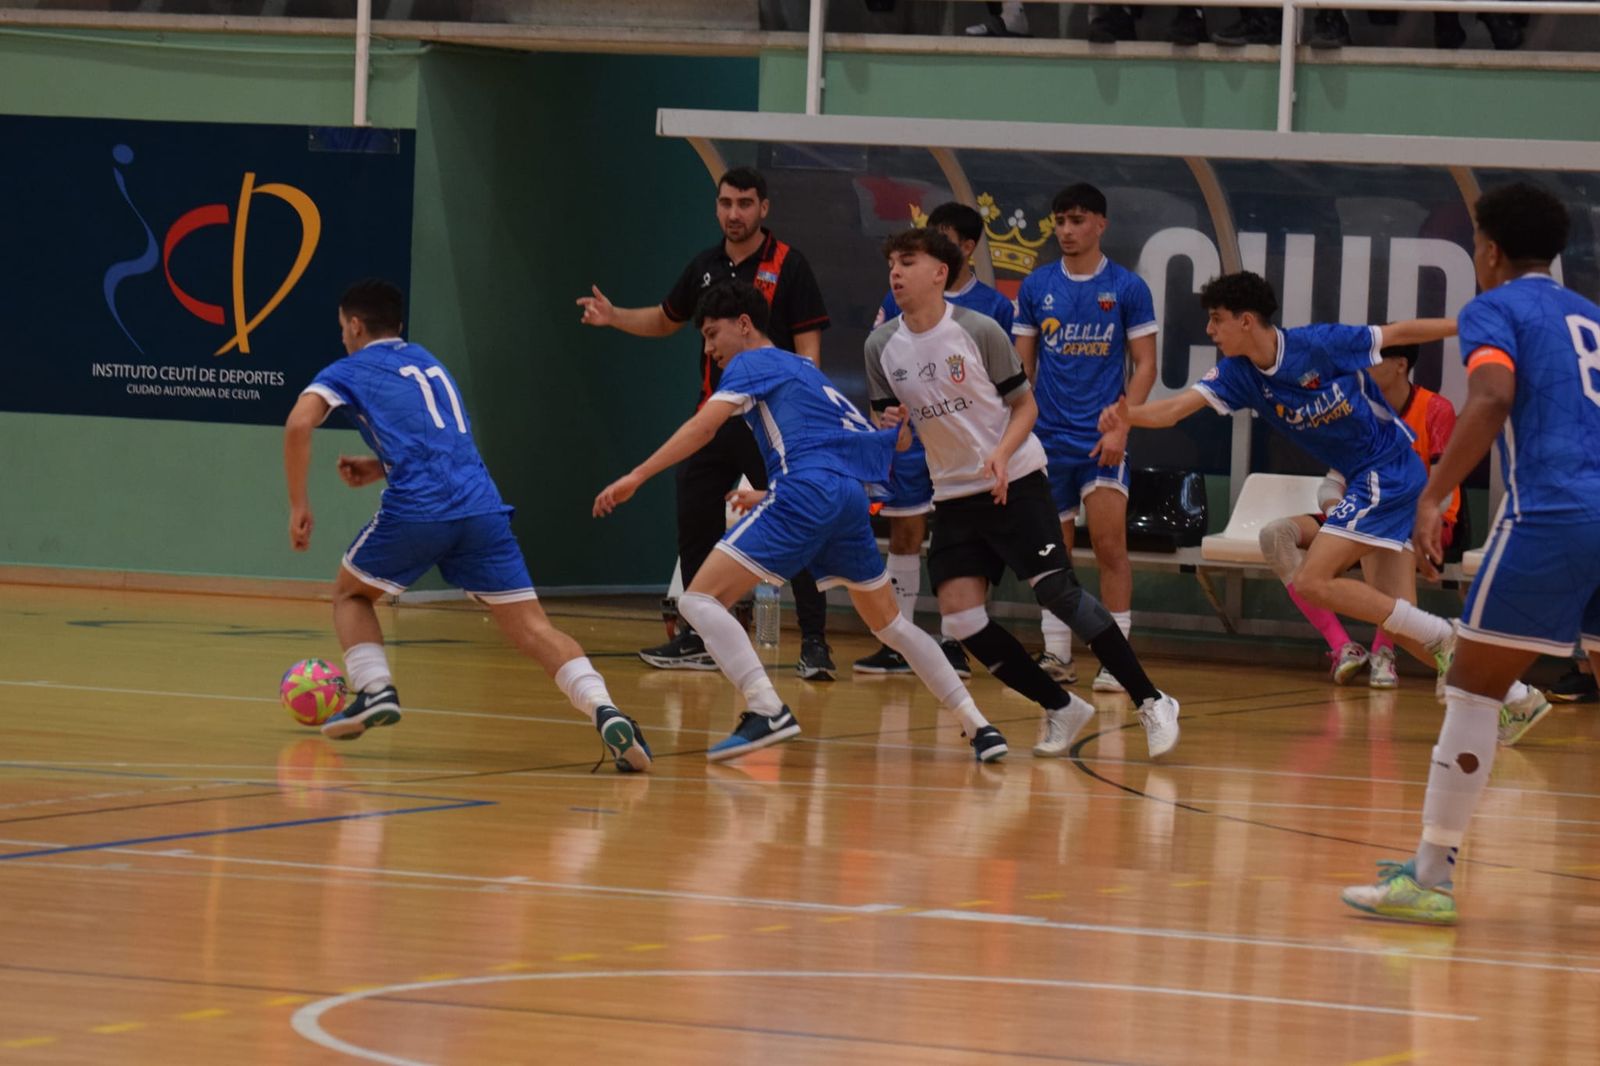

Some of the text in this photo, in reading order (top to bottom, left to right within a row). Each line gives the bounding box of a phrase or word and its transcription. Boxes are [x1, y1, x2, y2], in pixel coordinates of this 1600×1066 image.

[92, 363, 285, 386] INSTITUTO CEUTÍ DE DEPORTES
[126, 383, 261, 400] CIUDAD AUTÓNOMA DE CEUTA
[399, 365, 467, 434] 11
